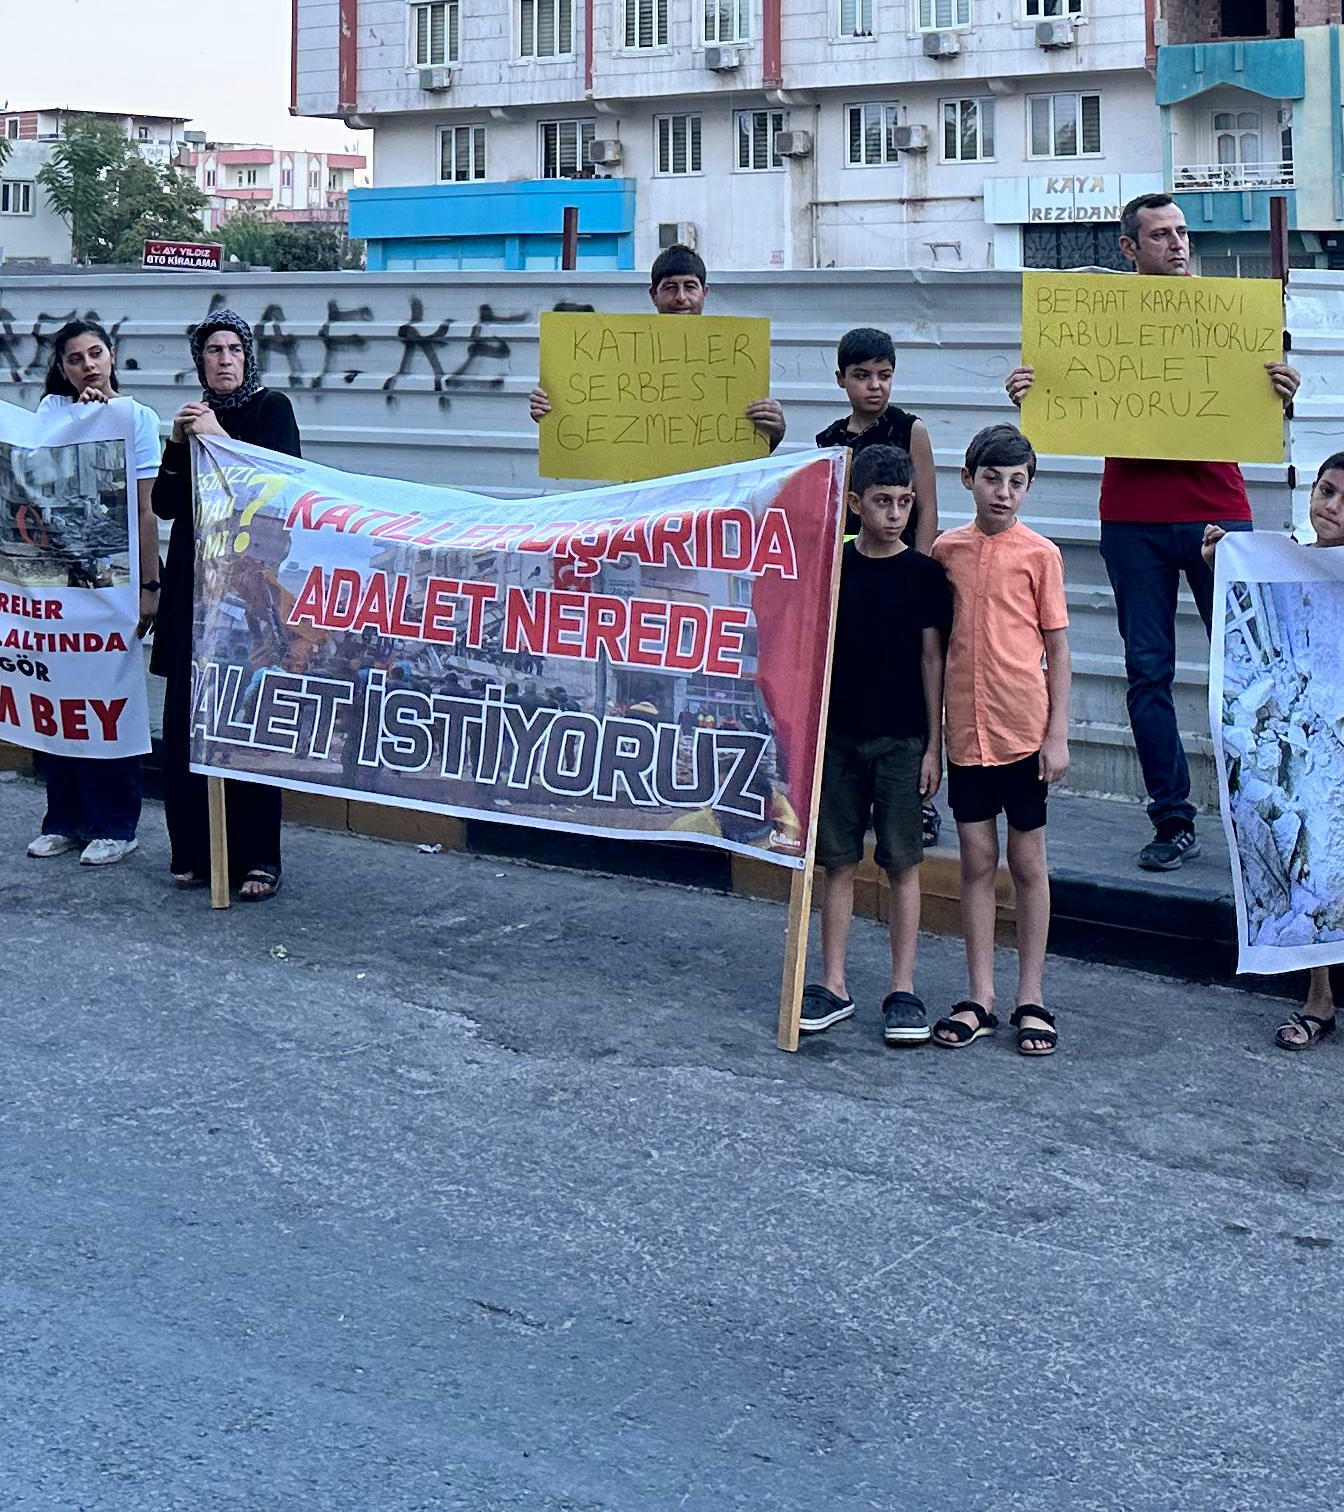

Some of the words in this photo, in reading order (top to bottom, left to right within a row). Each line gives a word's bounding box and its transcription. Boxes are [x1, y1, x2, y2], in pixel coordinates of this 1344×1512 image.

[1046, 175, 1105, 194] KAYA
[146, 255, 166, 264] OTO
[1036, 287, 1128, 315] BERAAT
[1140, 289, 1245, 316] KARARINI
[573, 324, 757, 370] KATİLLER
[1038, 320, 1134, 349] KABUL
[1139, 318, 1276, 352] ETMİYORUZ
[1064, 354, 1217, 385] ADALET
[565, 371, 737, 405] SERBEST
[283, 490, 524, 550] KATİLLER
[518, 507, 799, 580] DIŞARIDA
[286, 565, 499, 649] ADALET
[503, 585, 753, 678] NEREDE
[29, 692, 129, 741] BEY
[357, 668, 772, 820] İSTİYORUZ
